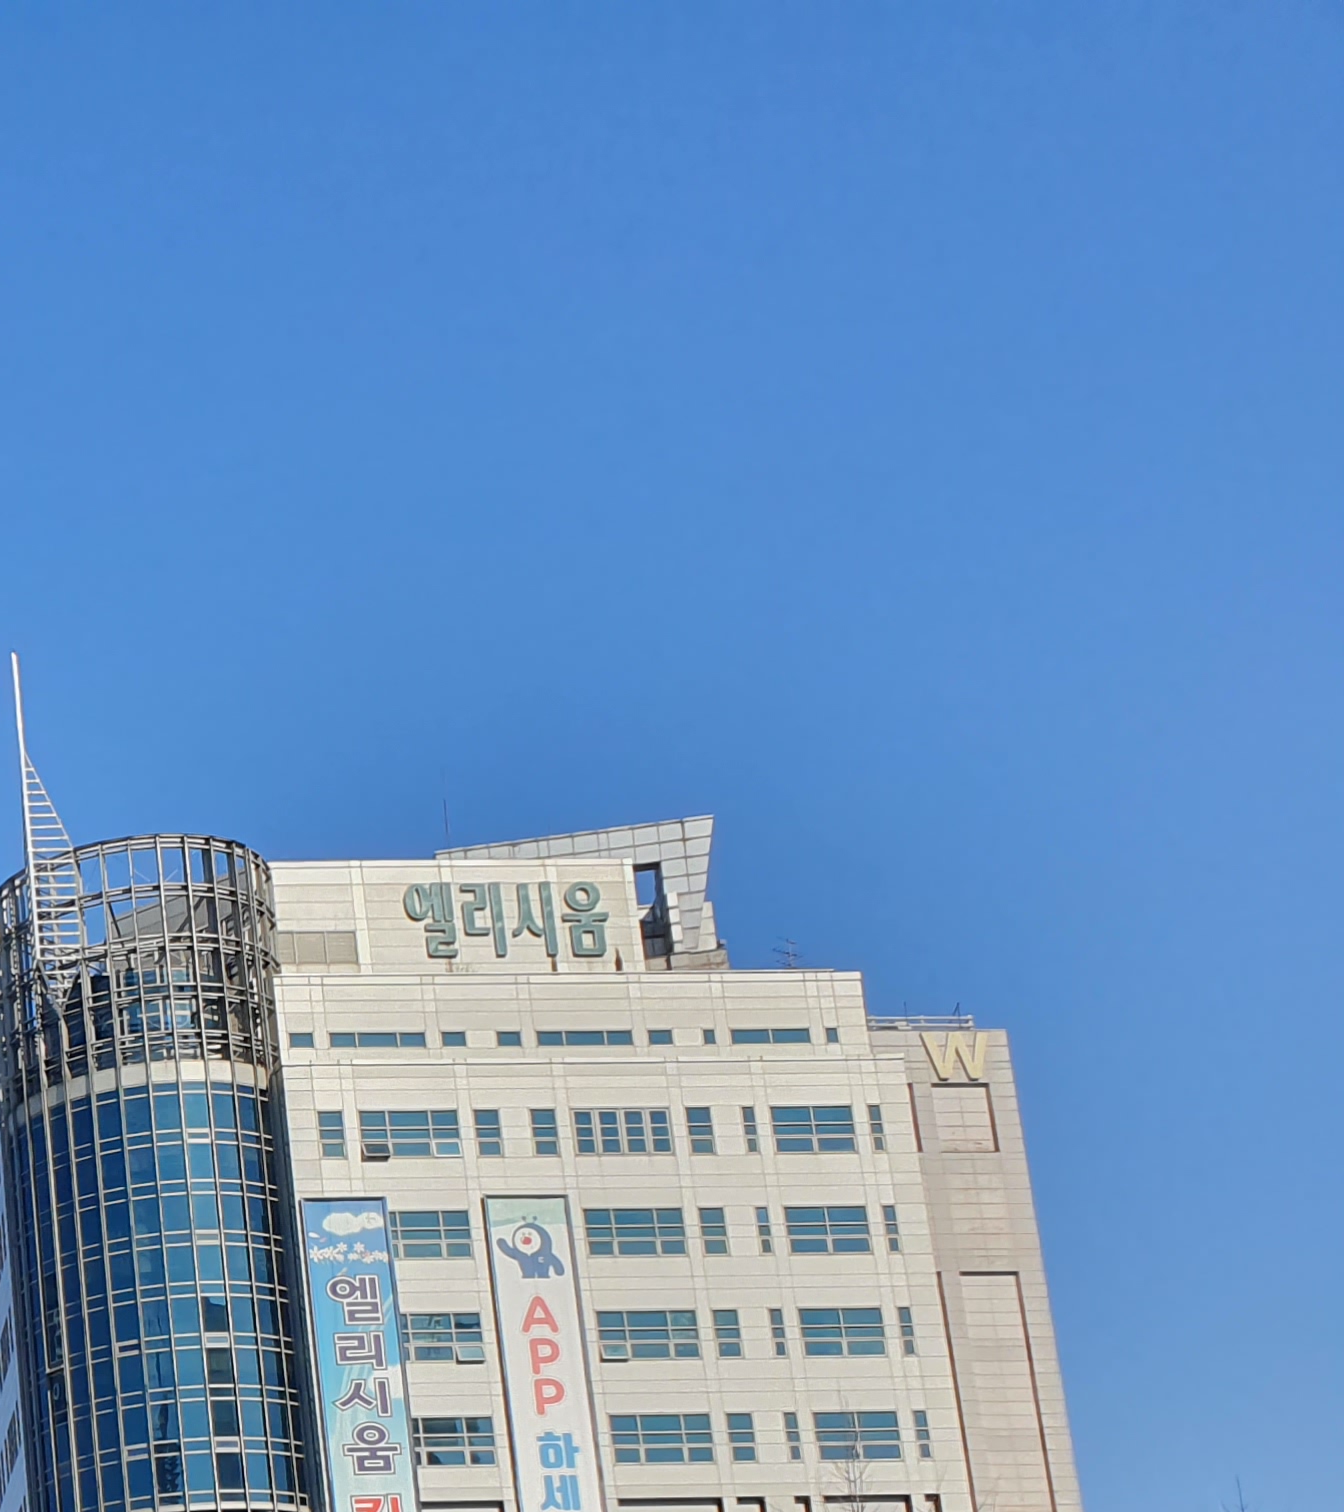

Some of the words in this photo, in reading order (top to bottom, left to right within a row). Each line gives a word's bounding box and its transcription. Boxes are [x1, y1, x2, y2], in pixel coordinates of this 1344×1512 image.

[402, 880, 610, 959] 엘리시움
[326, 1273, 402, 1475] 엘리시움
[520, 1295, 566, 1416] APP
